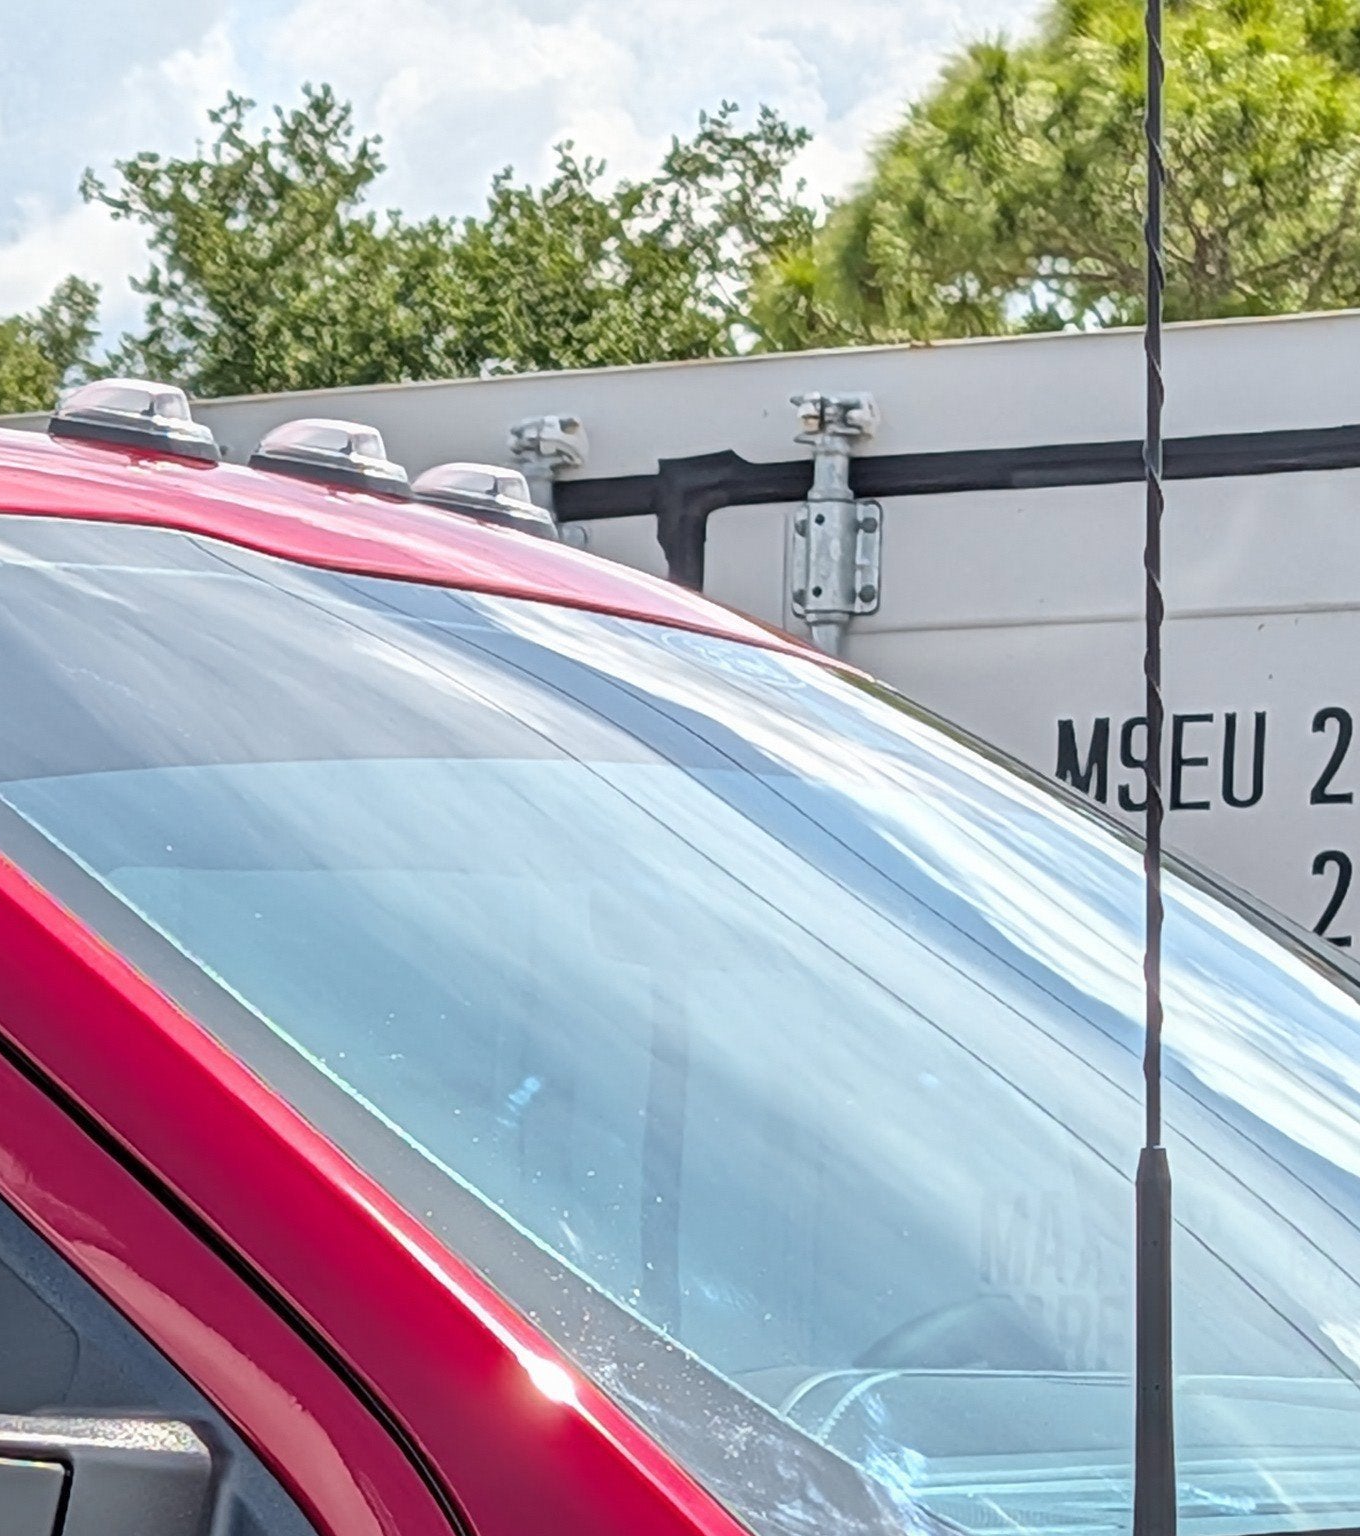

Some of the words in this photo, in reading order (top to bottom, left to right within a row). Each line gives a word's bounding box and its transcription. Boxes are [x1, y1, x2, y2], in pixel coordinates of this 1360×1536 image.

[1056, 710, 1267, 812] MSEU
[1310, 706, 1355, 805] 2
[1311, 850, 1354, 947] 2
